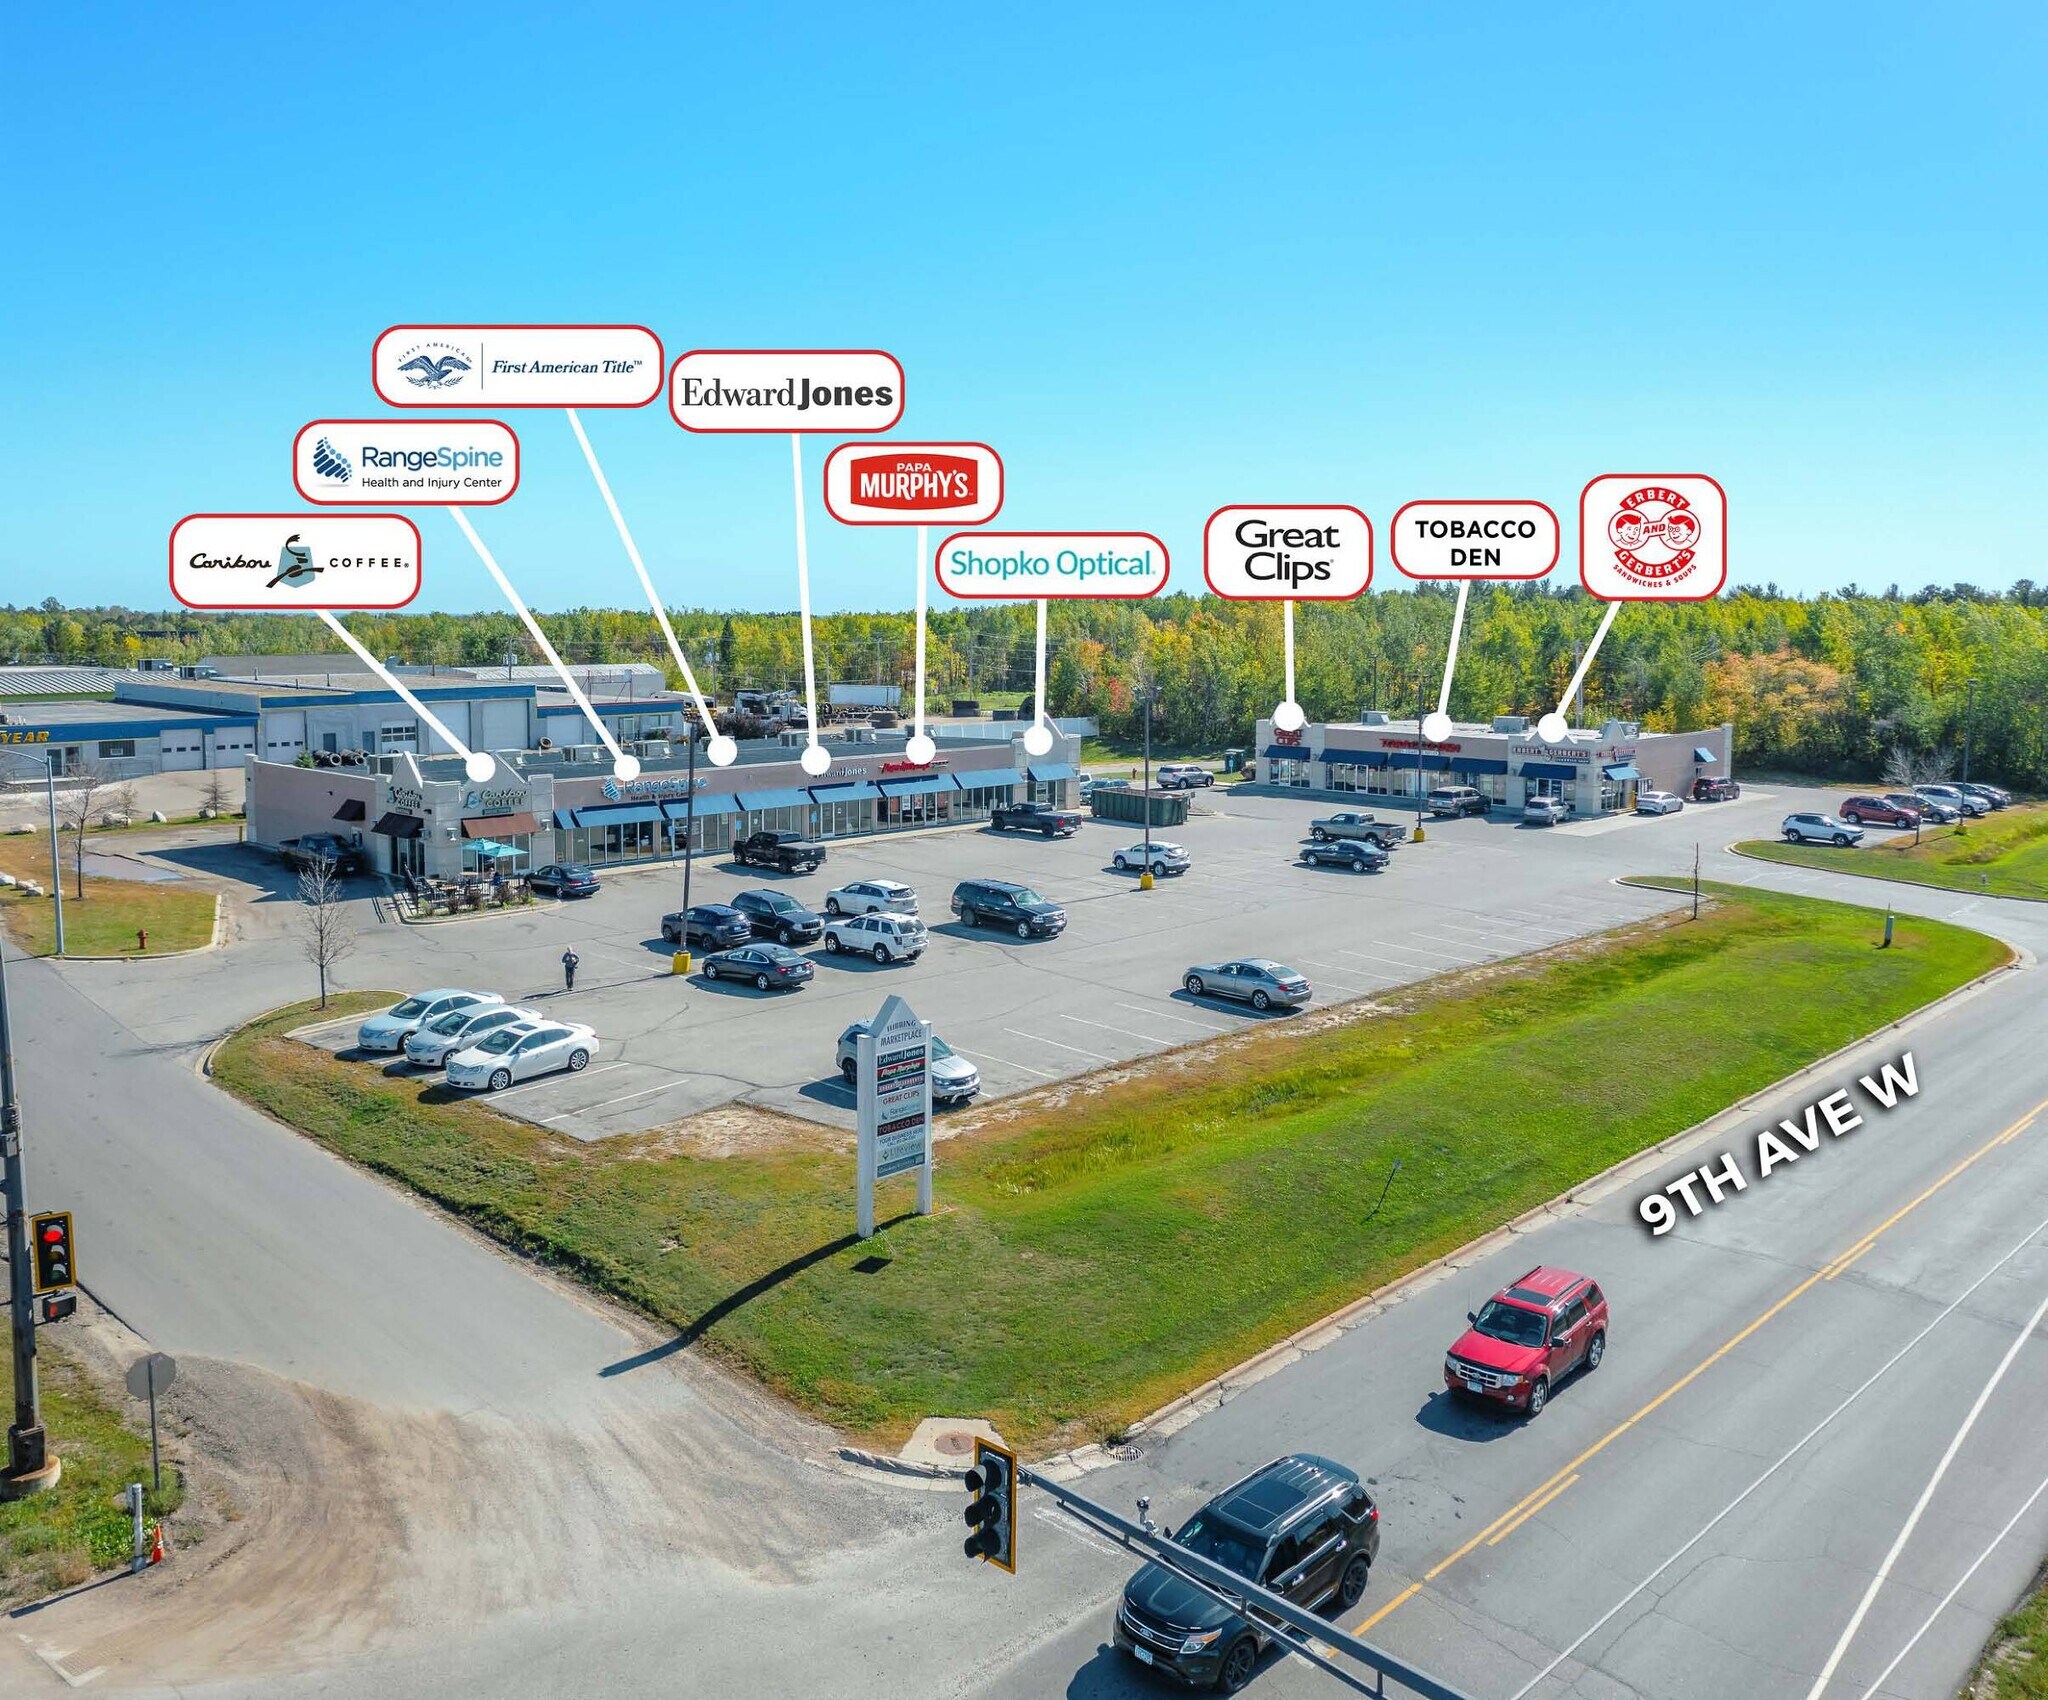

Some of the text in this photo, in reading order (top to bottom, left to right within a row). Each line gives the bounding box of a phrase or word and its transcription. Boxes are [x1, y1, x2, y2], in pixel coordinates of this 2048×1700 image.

[880, 1029, 922, 1047] MARKETPLACE
[883, 1094, 902, 1105] GREAT
[878, 1119, 910, 1134] TOBACCO
